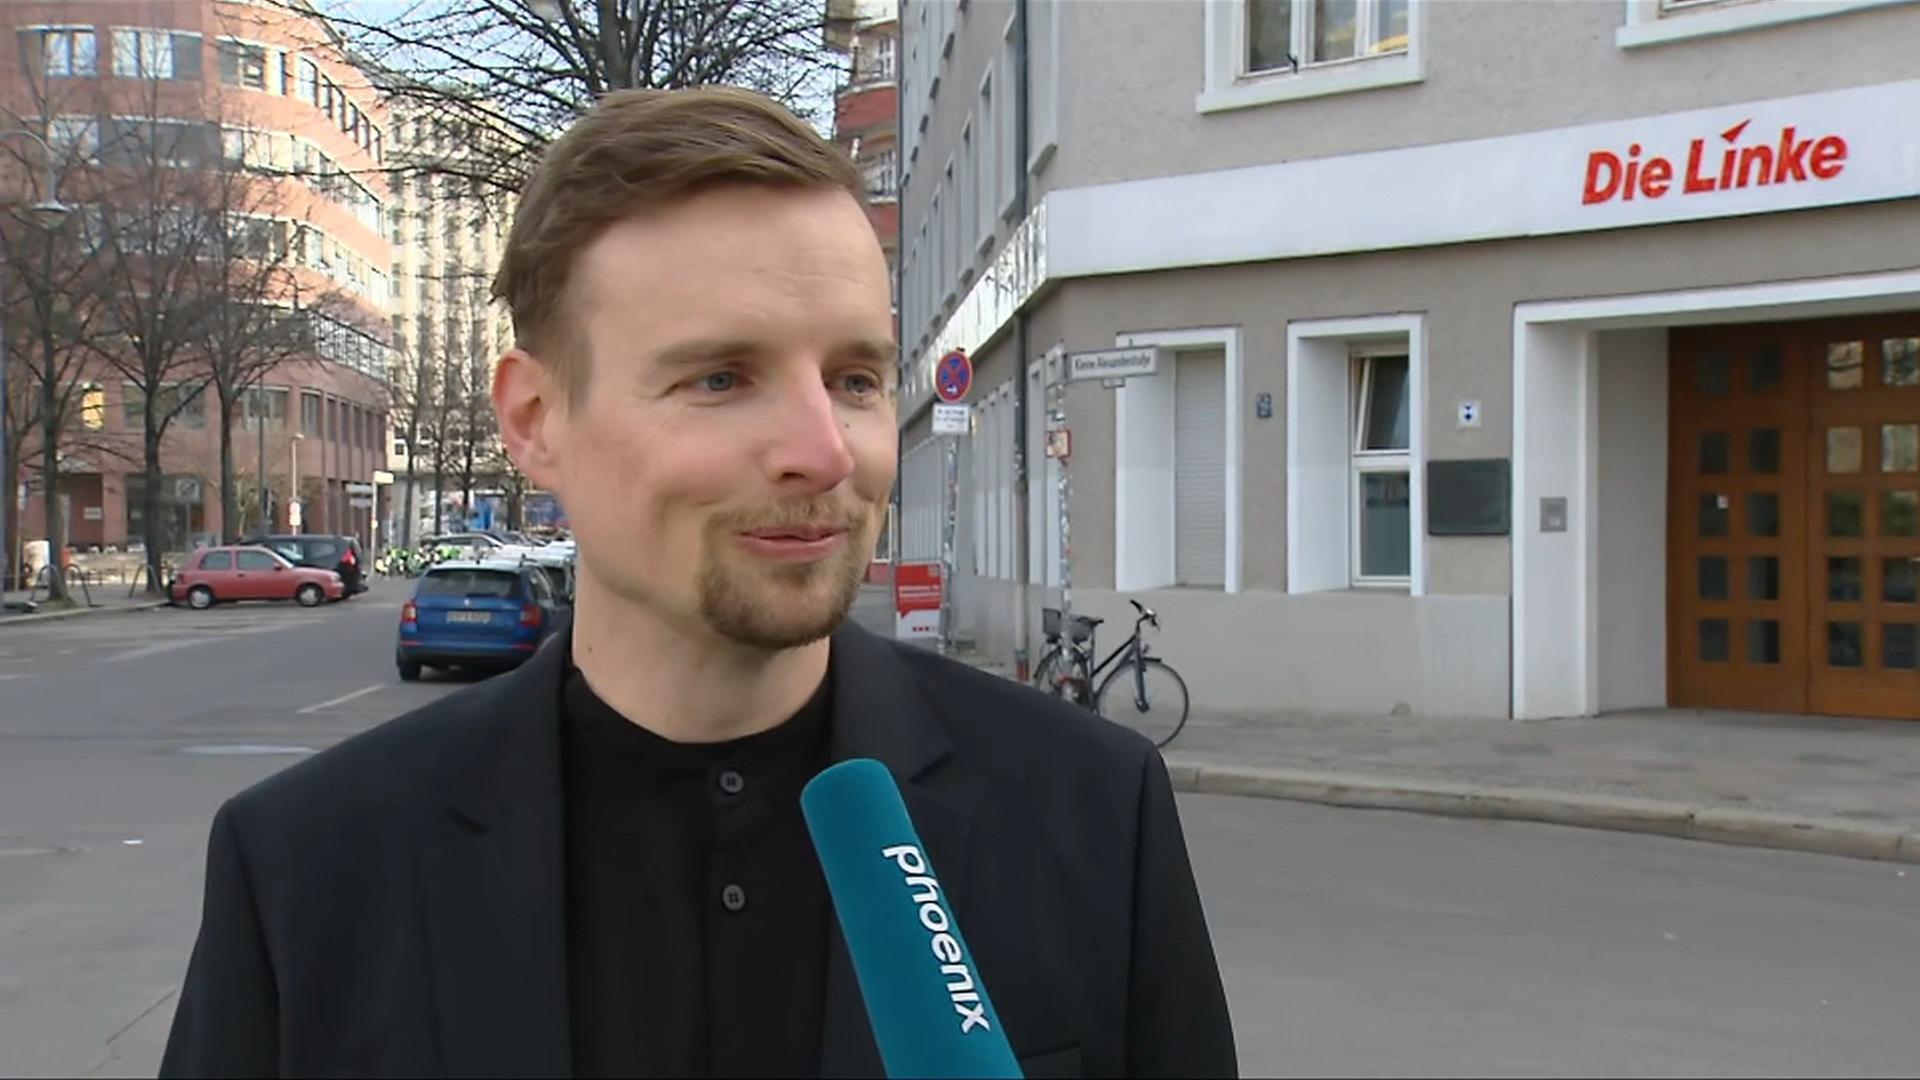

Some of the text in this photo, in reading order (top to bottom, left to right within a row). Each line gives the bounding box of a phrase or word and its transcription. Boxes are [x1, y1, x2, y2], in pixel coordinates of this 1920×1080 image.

[1582, 118, 1847, 205] Die Linke
[882, 845, 991, 1034] phoenix
